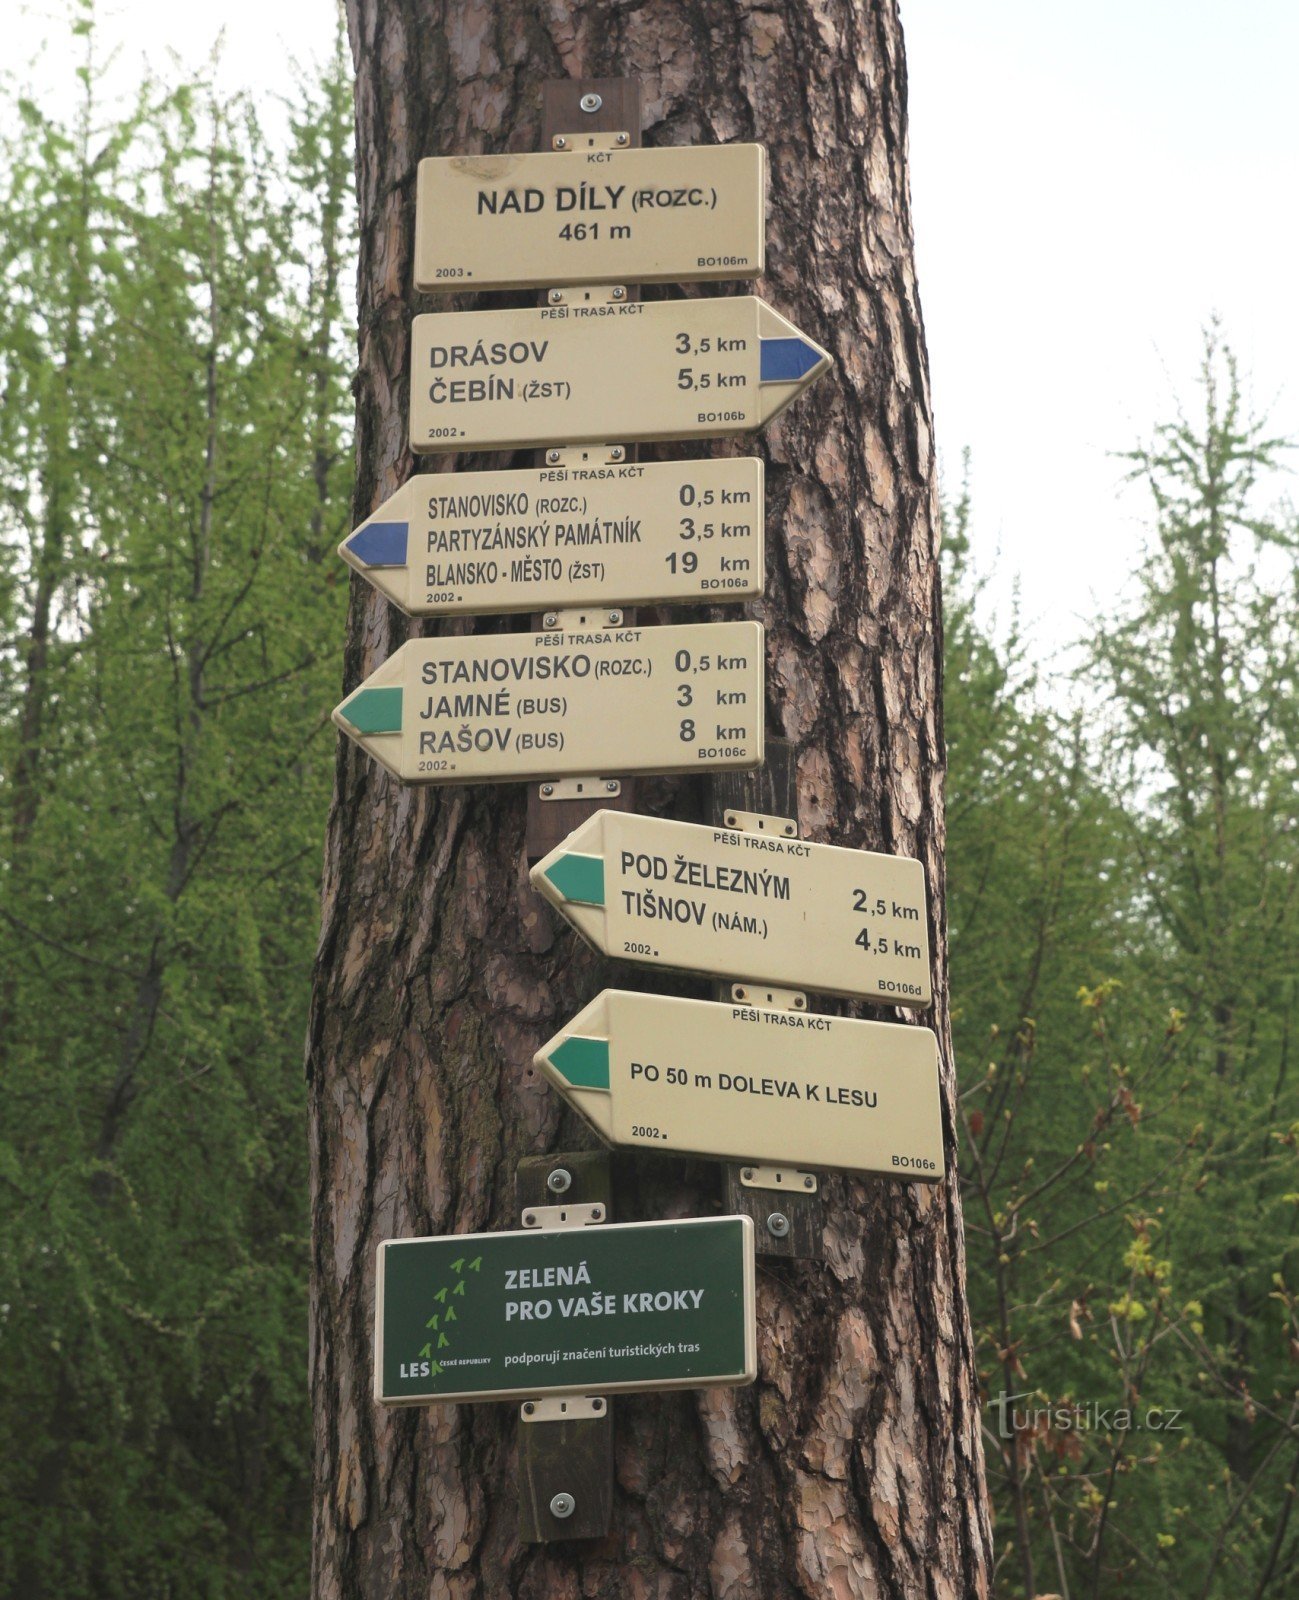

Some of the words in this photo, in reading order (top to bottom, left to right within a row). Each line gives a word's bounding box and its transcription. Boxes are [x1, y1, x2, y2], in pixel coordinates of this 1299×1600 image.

[587, 153, 612, 163] KČT
[477, 189, 545, 215] NAD
[556, 181, 625, 212] DÍLY
[632, 188, 717, 213] (ROZC.)
[559, 224, 599, 241] 461
[610, 226, 631, 239] m
[697, 257, 748, 267] BO106m
[541, 308, 570, 319] PĚŠÍ
[574, 307, 615, 318] TRASA
[619, 304, 644, 315] KČT
[430, 341, 549, 368] DRÁSOV
[675, 333, 710, 356] 3,5
[718, 337, 747, 352] km
[429, 376, 514, 404] ČEBÍN
[522, 380, 571, 403] (ŽST)
[677, 369, 712, 392] 5,5
[718, 373, 747, 388] km
[698, 412, 745, 423] BO106b
[540, 470, 568, 482] PĚŠÍ
[572, 469, 615, 481] TRASA
[618, 468, 644, 478] KČT
[428, 493, 529, 519] STANOVISKO
[535, 497, 587, 518] (ROZC.)
[679, 484, 714, 508] 0,5
[721, 489, 751, 505] km
[427, 521, 549, 552] PARTYZÁNSKÝ
[555, 517, 642, 546] PAMÁTNÍK
[679, 518, 715, 540] 3,5
[721, 523, 751, 538] km
[426, 561, 497, 587] BLANSKO
[511, 555, 562, 582] MĚSTO
[568, 563, 605, 582] (ŽST)
[665, 552, 698, 574] 19
[721, 557, 750, 572] km
[701, 578, 748, 589] BO106a
[535, 634, 564, 647] PĚŠÍ
[568, 633, 612, 645] TRASA
[615, 631, 642, 643] KČT
[421, 655, 591, 685] STANOVISKO
[594, 657, 652, 679] (ROZC.)
[675, 650, 710, 673] 0,5
[717, 655, 747, 670] km
[420, 688, 511, 719] JAMNÉ
[516, 697, 567, 718] (BUS)
[677, 685, 693, 707] 3
[717, 689, 747, 705] km
[419, 724, 512, 755] RAŠOV
[515, 733, 564, 752] (BUS)
[680, 719, 696, 742] 8
[716, 724, 746, 740] km
[698, 747, 746, 758] BO106c
[714, 832, 741, 846] PĚŠÍ
[744, 837, 784, 853] TRASA
[787, 844, 811, 857] KČT
[621, 852, 668, 881] POD
[674, 855, 790, 900] ŽELEZNÝM
[622, 889, 706, 925] TIŠNOV
[712, 912, 768, 939] (NÁM.)
[852, 889, 886, 917] 2,5
[892, 898, 919, 920] km
[855, 928, 889, 955] 4,5
[894, 937, 921, 958] km
[878, 980, 922, 995] BO106d
[733, 1009, 760, 1022] PĚŠÍ
[764, 1013, 804, 1028] TRASA
[807, 1017, 831, 1031] KČT
[630, 1063, 659, 1081] PO
[666, 1068, 688, 1085] 50
[694, 1073, 711, 1087] m
[719, 1074, 800, 1098] DOLEVA
[806, 1085, 819, 1100] K
[826, 1088, 878, 1107] LESU
[892, 1155, 935, 1170] BO106e
[505, 1261, 591, 1289] ZELENÁ
[505, 1300, 552, 1321] PRO
[558, 1292, 616, 1317] VAŠE
[623, 1289, 704, 1313] KROKY
[440, 1358, 458, 1366] ČESKÉ
[505, 1350, 560, 1367] podporují
[563, 1346, 606, 1361] značení
[609, 1342, 675, 1358] turistických
[678, 1341, 700, 1353] tras
